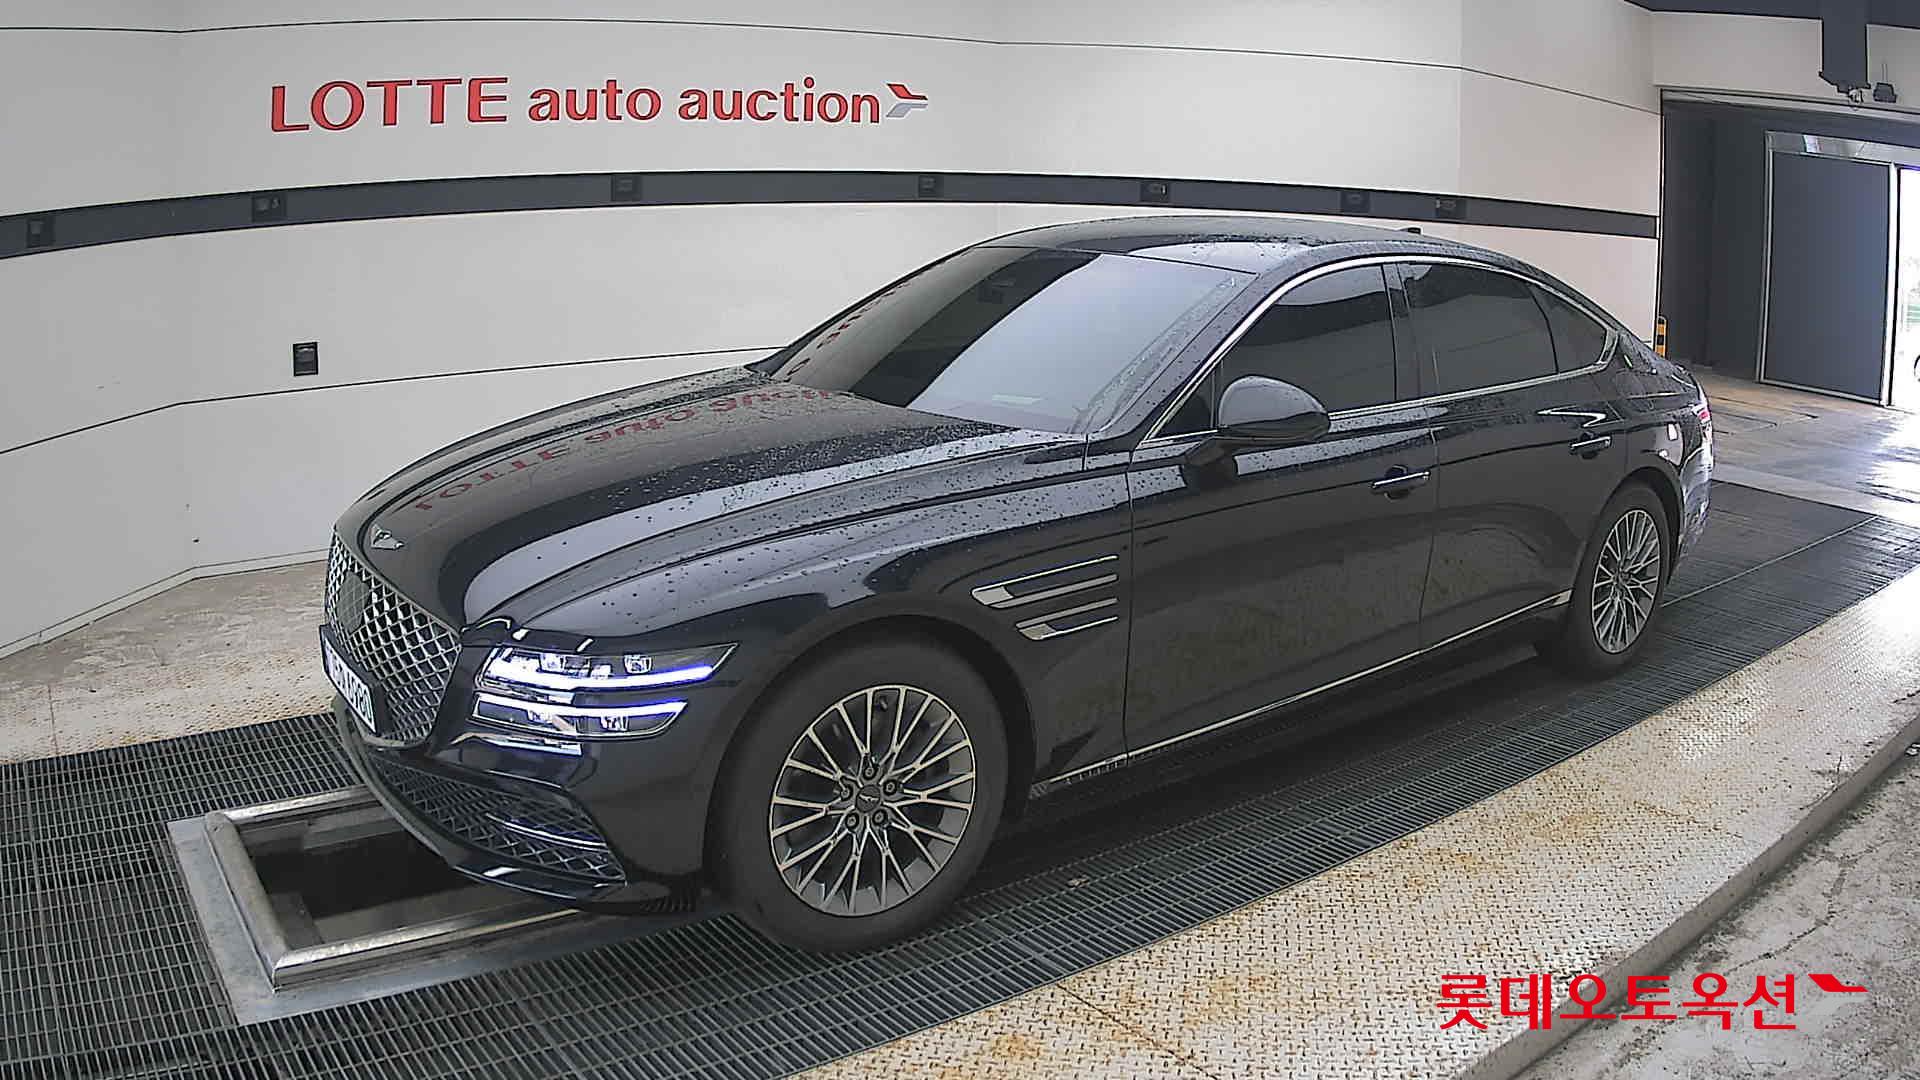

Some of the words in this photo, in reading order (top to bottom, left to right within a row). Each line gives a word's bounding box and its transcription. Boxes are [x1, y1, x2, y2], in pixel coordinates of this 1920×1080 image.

[271, 77, 508, 133] LOTTE
[528, 79, 662, 122] auto
[678, 76, 880, 124] auction
